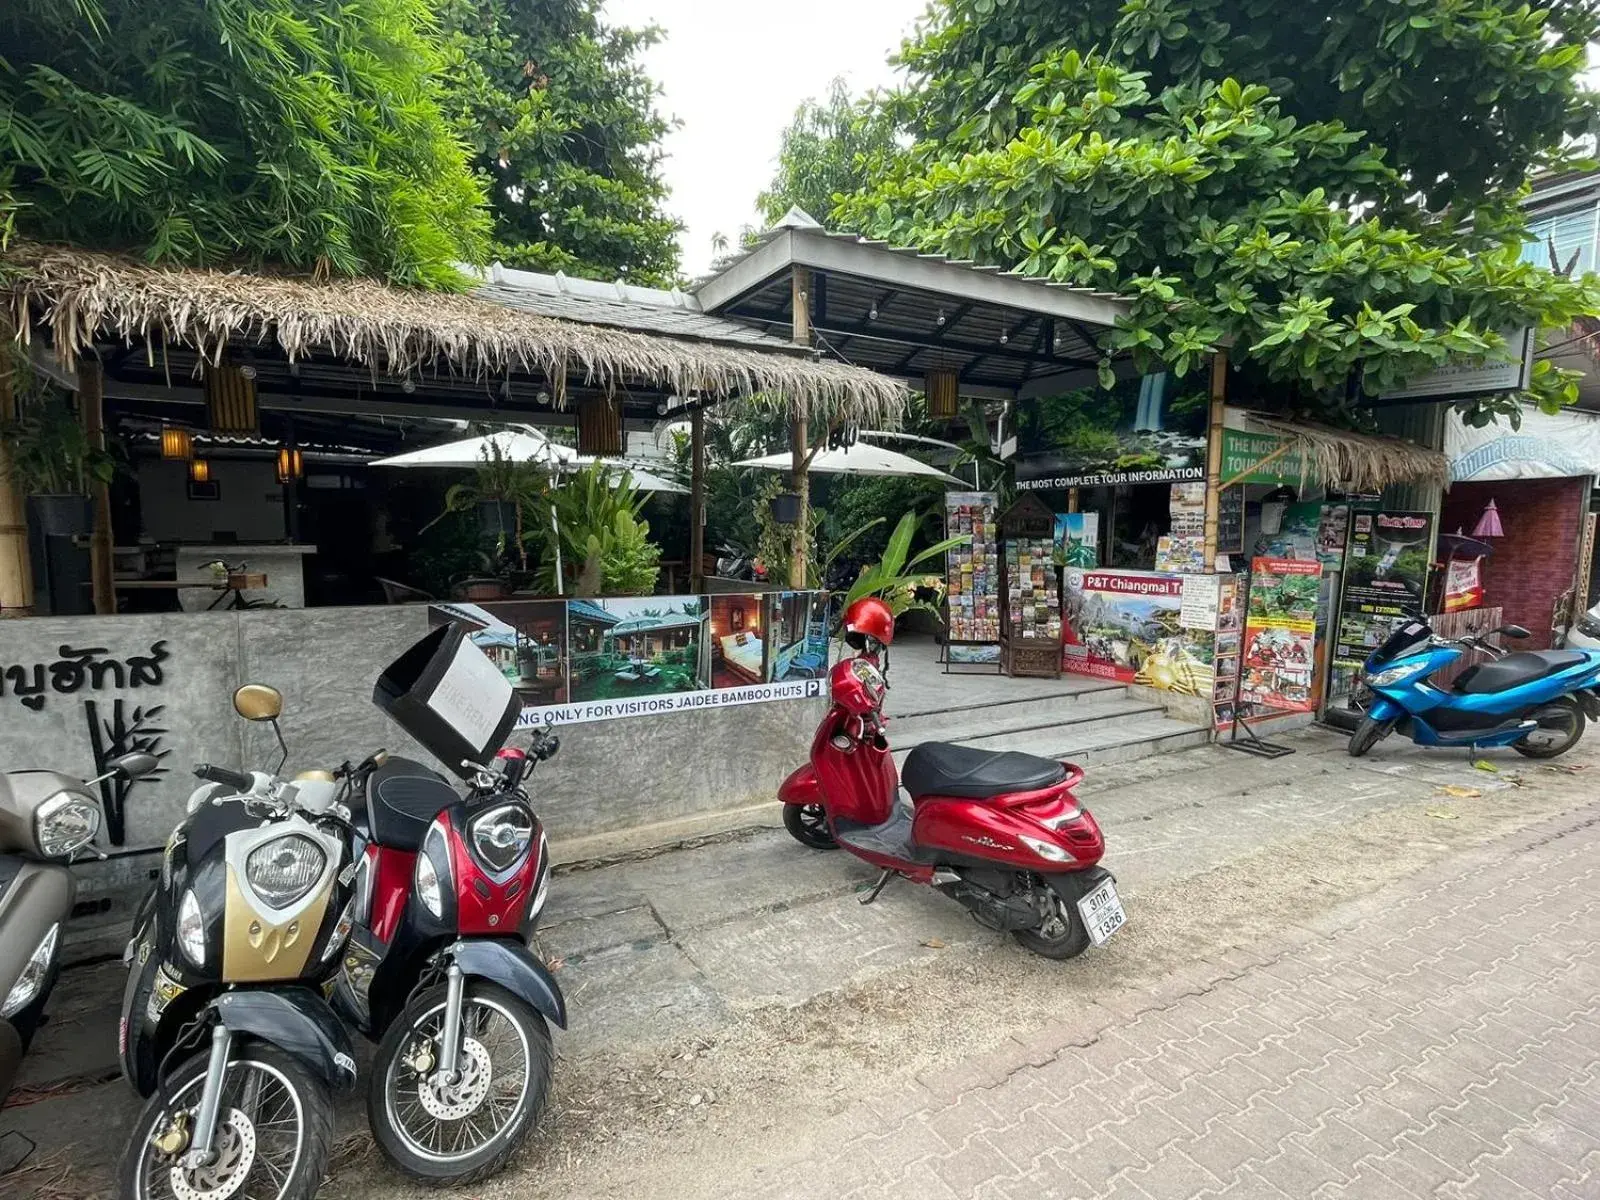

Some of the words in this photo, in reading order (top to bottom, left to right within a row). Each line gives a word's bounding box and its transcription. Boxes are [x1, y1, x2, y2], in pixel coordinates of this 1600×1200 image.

[1228, 437, 1249, 453] THE
[1016, 481, 1031, 490] THE
[1031, 479, 1053, 489] MOST
[1055, 475, 1100, 487] COMPLETE
[1101, 472, 1127, 484] TOUR
[1128, 467, 1203, 482] INFORMATION
[1087, 576, 1109, 588] P&T
[1110, 578, 1169, 594] Chiangmai
[0, 640, 170, 711] บูฮัทส์
[544, 708, 582, 722] ONLY
[587, 705, 613, 718] FOR
[615, 698, 673, 714] VISITORS
[677, 694, 718, 708] JAIDEE
[721, 688, 771, 703] BAMBOO
[773, 685, 802, 697] HUTS
[1099, 911, 1122, 937] 1326
